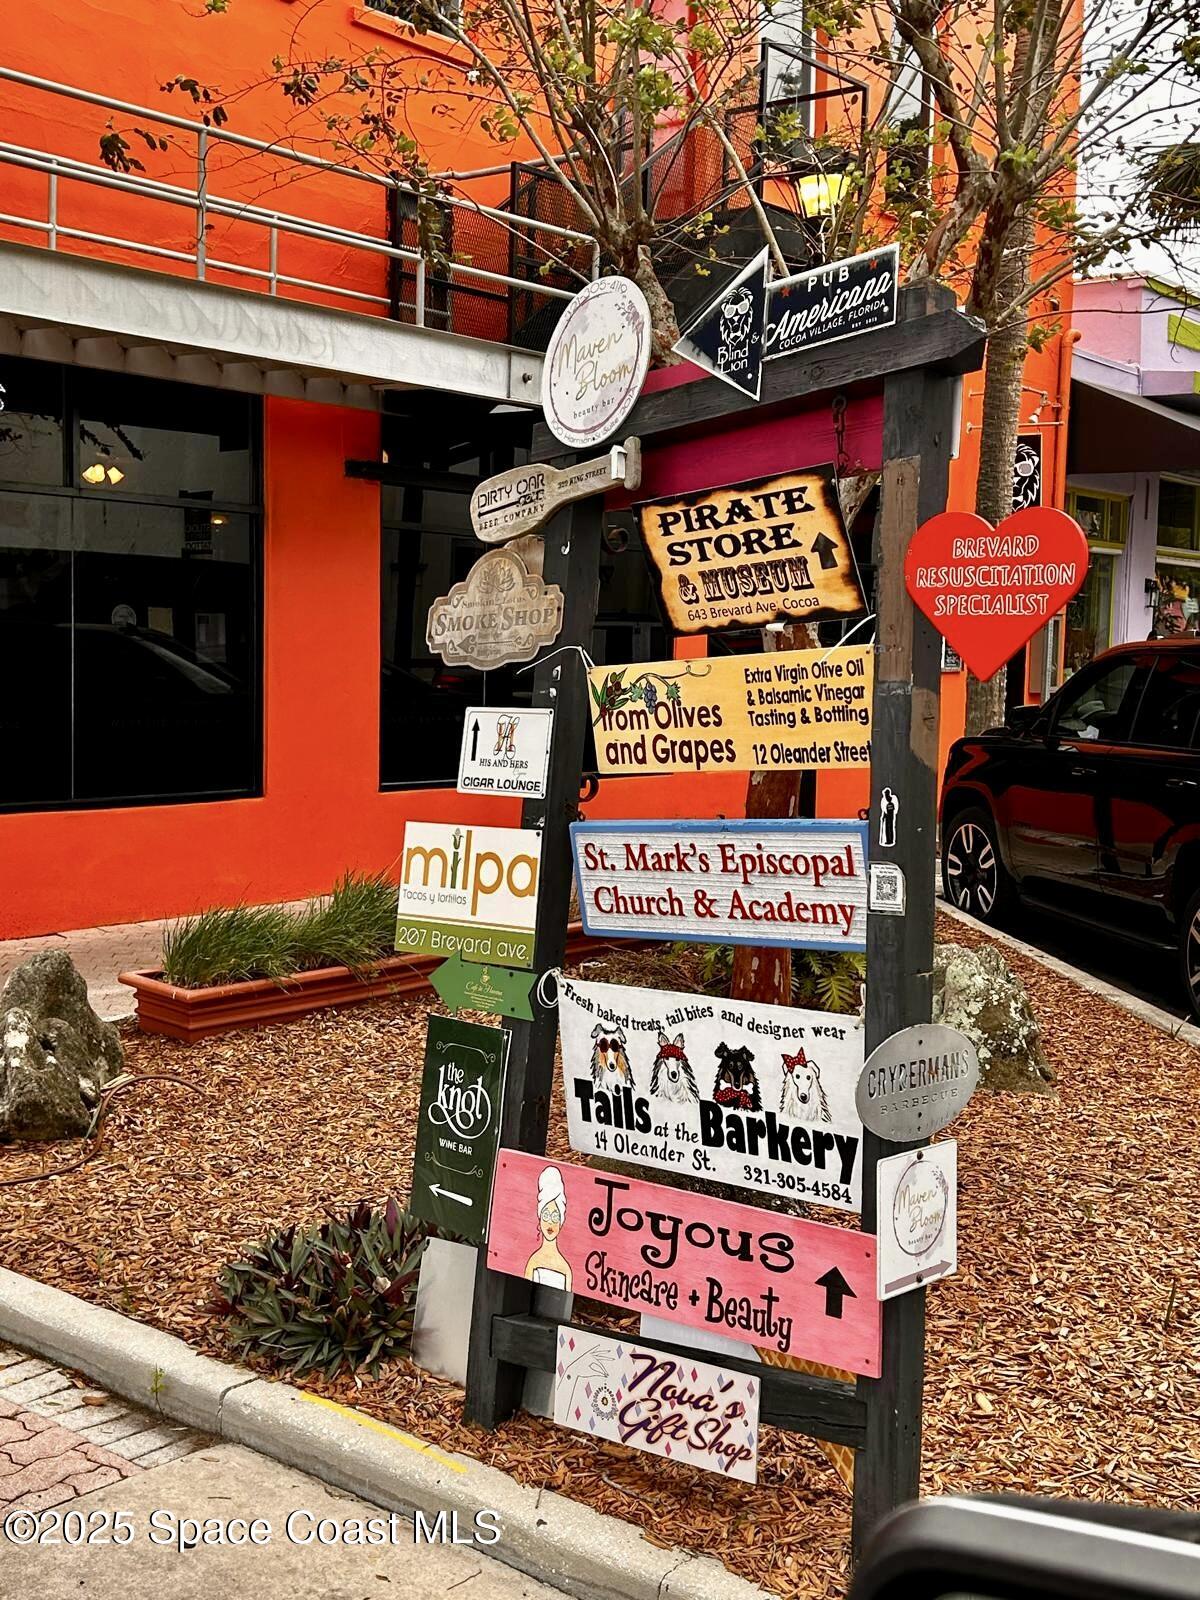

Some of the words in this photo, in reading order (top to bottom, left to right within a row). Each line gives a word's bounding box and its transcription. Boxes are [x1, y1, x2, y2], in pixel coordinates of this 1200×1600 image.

[808, 266, 849, 292] PUB
[762, 271, 893, 347] Americana
[751, 332, 760, 344] &
[779, 334, 807, 350] COCOA
[848, 298, 886, 321] FLORIDA
[558, 333, 623, 378] Maven
[717, 339, 749, 364] Blind
[721, 358, 748, 374] Lion
[575, 360, 633, 401] Bloom
[573, 404, 599, 419] beauty
[602, 396, 615, 408] bar
[585, 466, 607, 480] STREET
[477, 484, 513, 509] DIRTY
[516, 473, 545, 495] OAR
[503, 504, 545, 523] COMPANY
[657, 486, 816, 537] PIRATE
[666, 522, 803, 566] STORE
[952, 535, 1040, 559] BREVARD
[677, 573, 699, 605] &
[698, 555, 815, 602] MUSEUM
[916, 563, 1076, 588] RESUSCITATION
[687, 608, 708, 621] 643
[710, 602, 753, 619] Brevard
[783, 597, 820, 609] Cocoa
[934, 594, 1050, 616] SPECIALIST
[435, 613, 498, 636] SMOKE
[501, 606, 555, 631] SHOP
[744, 666, 772, 684] Extra
[774, 662, 809, 685] Virgin
[811, 659, 844, 679] Olive
[846, 657, 865, 677] Oil
[746, 690, 756, 706] &
[758, 685, 812, 706] Balsamic
[814, 683, 866, 703] Vinegar
[653, 701, 723, 730] Olives
[747, 710, 796, 728] Tasting
[800, 709, 811, 724] &
[814, 705, 869, 725] Bottling
[479, 758, 491, 767] HIS
[492, 759, 508, 767] AND
[509, 760, 529, 769] HERS
[605, 734, 648, 765] and
[651, 734, 737, 770] Grapes
[752, 744, 768, 764] 12
[770, 742, 831, 765] Oleander
[834, 741, 872, 763] Street
[463, 777, 495, 788] CIGAR
[497, 778, 541, 792] LOUNGE
[404, 828, 538, 916] milpa
[584, 842, 617, 871] St.
[622, 843, 710, 873] Mark's
[717, 843, 857, 887] Episcopal
[403, 888, 427, 901] Tacos
[429, 893, 436, 905] y
[437, 893, 467, 905] tortillas
[593, 886, 686, 917] Church
[693, 888, 720, 918] &
[727, 889, 855, 936] Academy
[398, 926, 427, 946] 207
[431, 931, 492, 955] Brevard
[497, 941, 530, 960] ave.
[563, 982, 594, 1013] Fresh
[596, 1004, 629, 1029] baked
[631, 1017, 666, 1032] treats,
[665, 1008, 685, 1027] tail
[685, 1004, 714, 1022] bites
[721, 1009, 744, 1027] and
[747, 1017, 806, 1040] designer
[811, 1025, 847, 1040] wear
[447, 1062, 465, 1084] the
[867, 1049, 969, 1099] CRYDERMANS
[428, 1064, 492, 1140] knot
[573, 1077, 651, 1134] Tails
[879, 1087, 959, 1115] BARBECUE
[438, 1138, 457, 1151] WINE
[458, 1143, 473, 1156] BAR
[653, 1124, 670, 1138] at
[674, 1122, 699, 1144] the
[700, 1099, 859, 1186] Barkery
[594, 1130, 608, 1151] 14
[614, 1135, 685, 1163] Oleander
[692, 1149, 717, 1172] St.
[743, 1165, 853, 1204] 321-305-4584
[899, 1185, 937, 1214] Maven
[588, 1177, 795, 1273] Joyous
[909, 1205, 943, 1233] Bloom
[585, 1250, 679, 1311] Skincare
[688, 1289, 700, 1307] +
[704, 1277, 793, 1353] Beauty
[628, 1353, 743, 1420] Nova's
[618, 1397, 688, 1444] Gift
[687, 1417, 753, 1473] Shop
